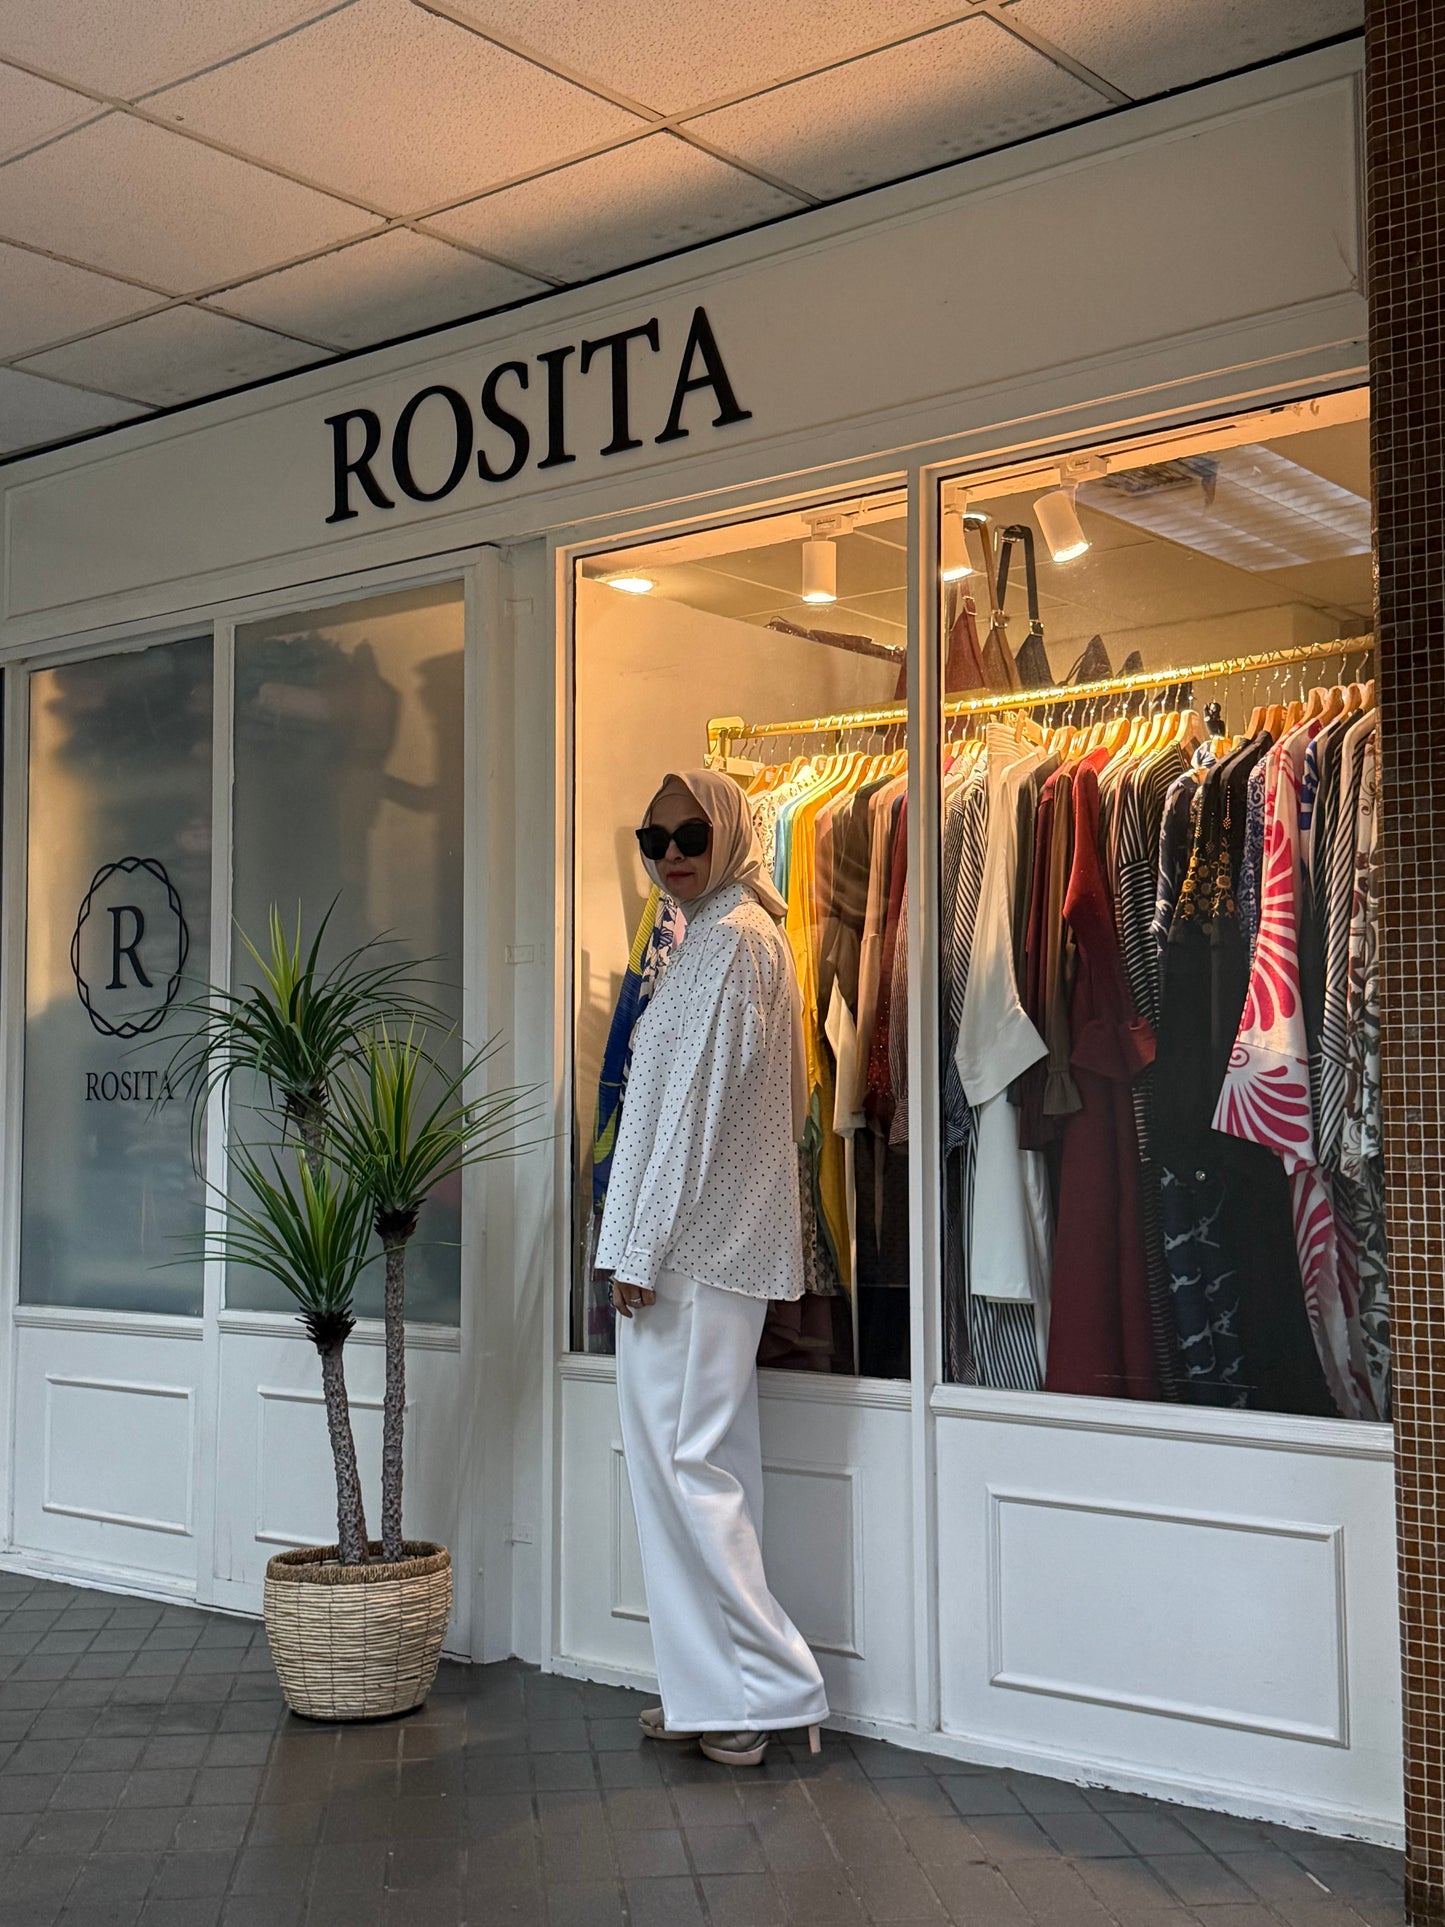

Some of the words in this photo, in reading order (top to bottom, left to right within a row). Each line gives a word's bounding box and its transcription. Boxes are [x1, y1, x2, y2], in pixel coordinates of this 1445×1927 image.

[324, 306, 752, 524] ROSITA
[105, 905, 153, 990] R
[85, 1071, 174, 1101] ROSITA
